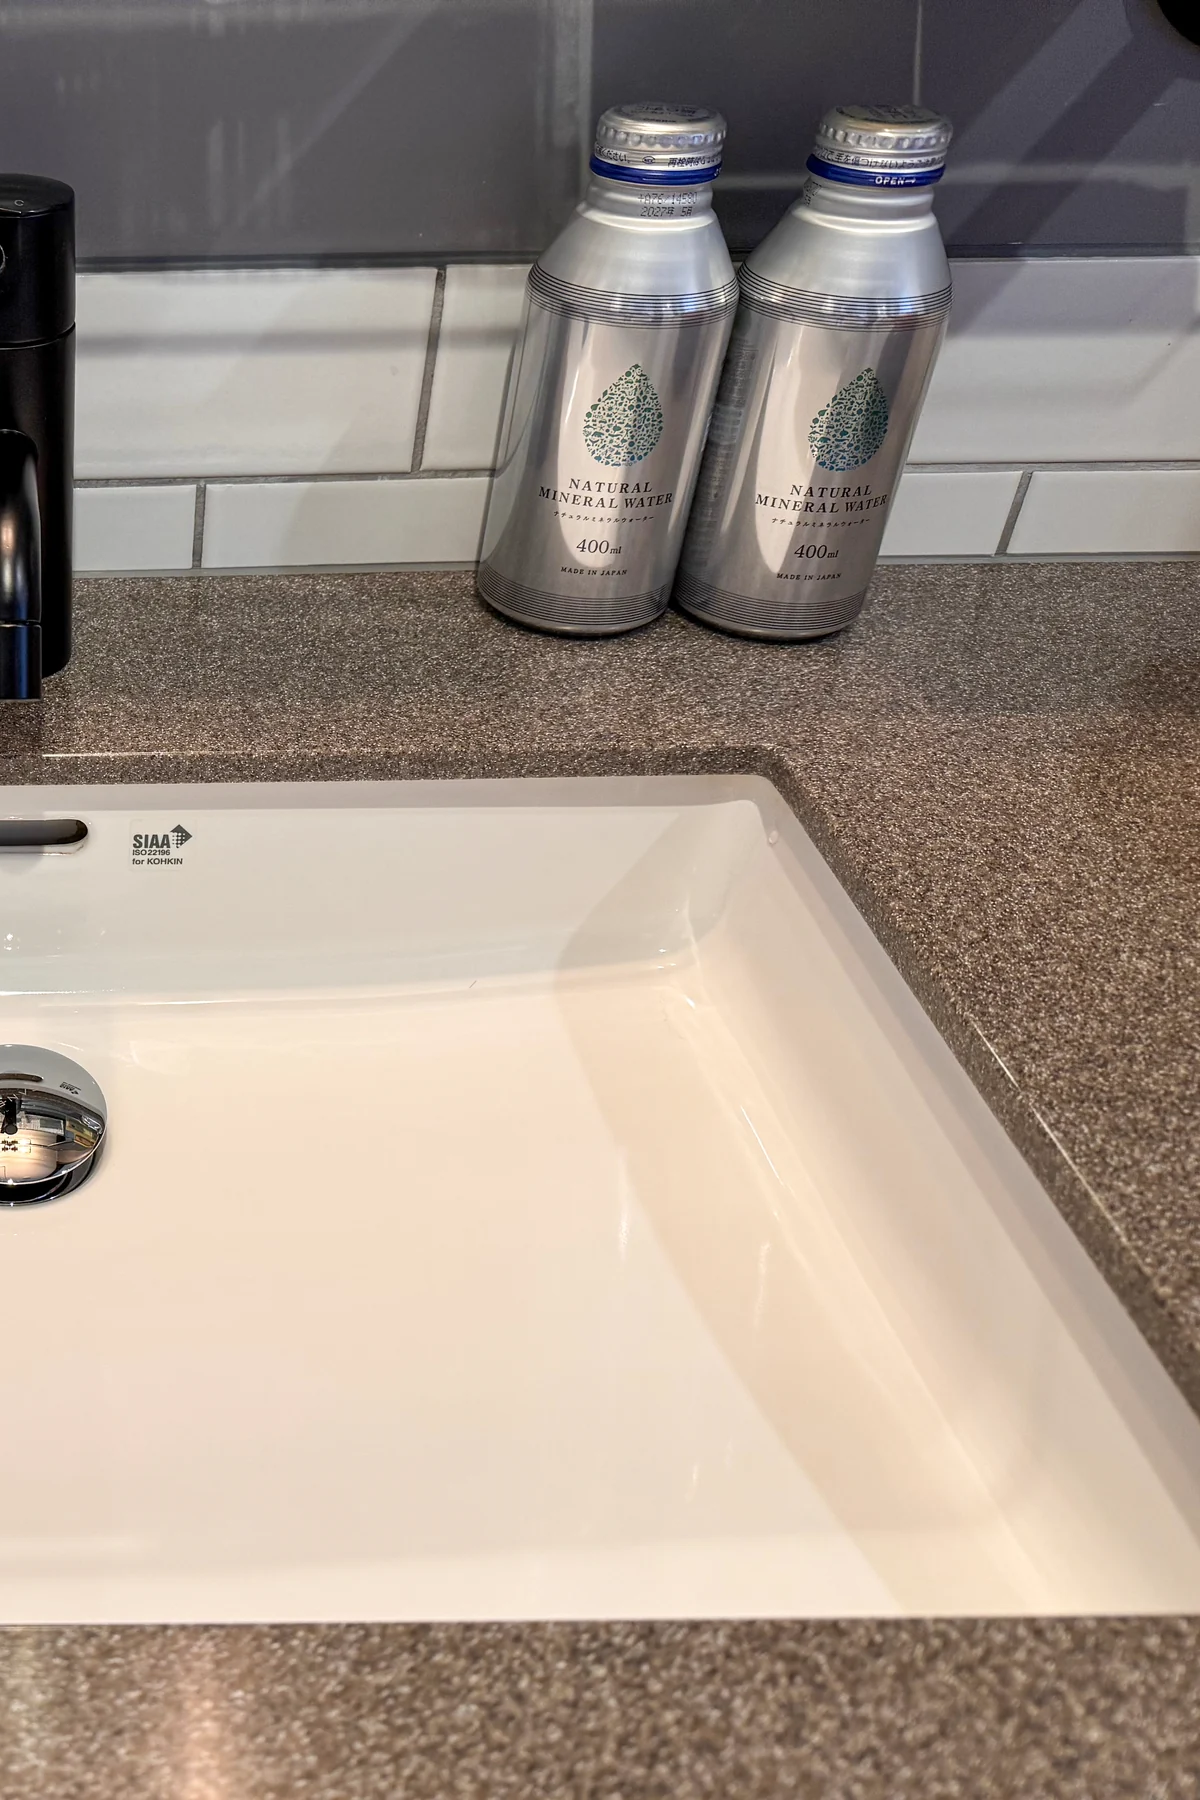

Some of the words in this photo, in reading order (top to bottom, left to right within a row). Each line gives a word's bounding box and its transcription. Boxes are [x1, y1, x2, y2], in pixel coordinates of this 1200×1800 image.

[875, 176, 905, 185] OPEN
[568, 478, 653, 493] NATURAL
[789, 484, 872, 498] NATURAL
[538, 486, 619, 509] MINERAL
[623, 492, 673, 509] WATER
[755, 494, 840, 513] MINERAL
[844, 494, 888, 513] WATER
[553, 510, 655, 523] ナチュラルミネラルウォーター
[576, 538, 622, 555] 400ml
[794, 544, 839, 559] 400ml
[560, 566, 584, 575] MADE
[600, 568, 628, 576] JAPAN
[816, 573, 842, 581] JAPAN
[132, 834, 171, 849] SIAA
